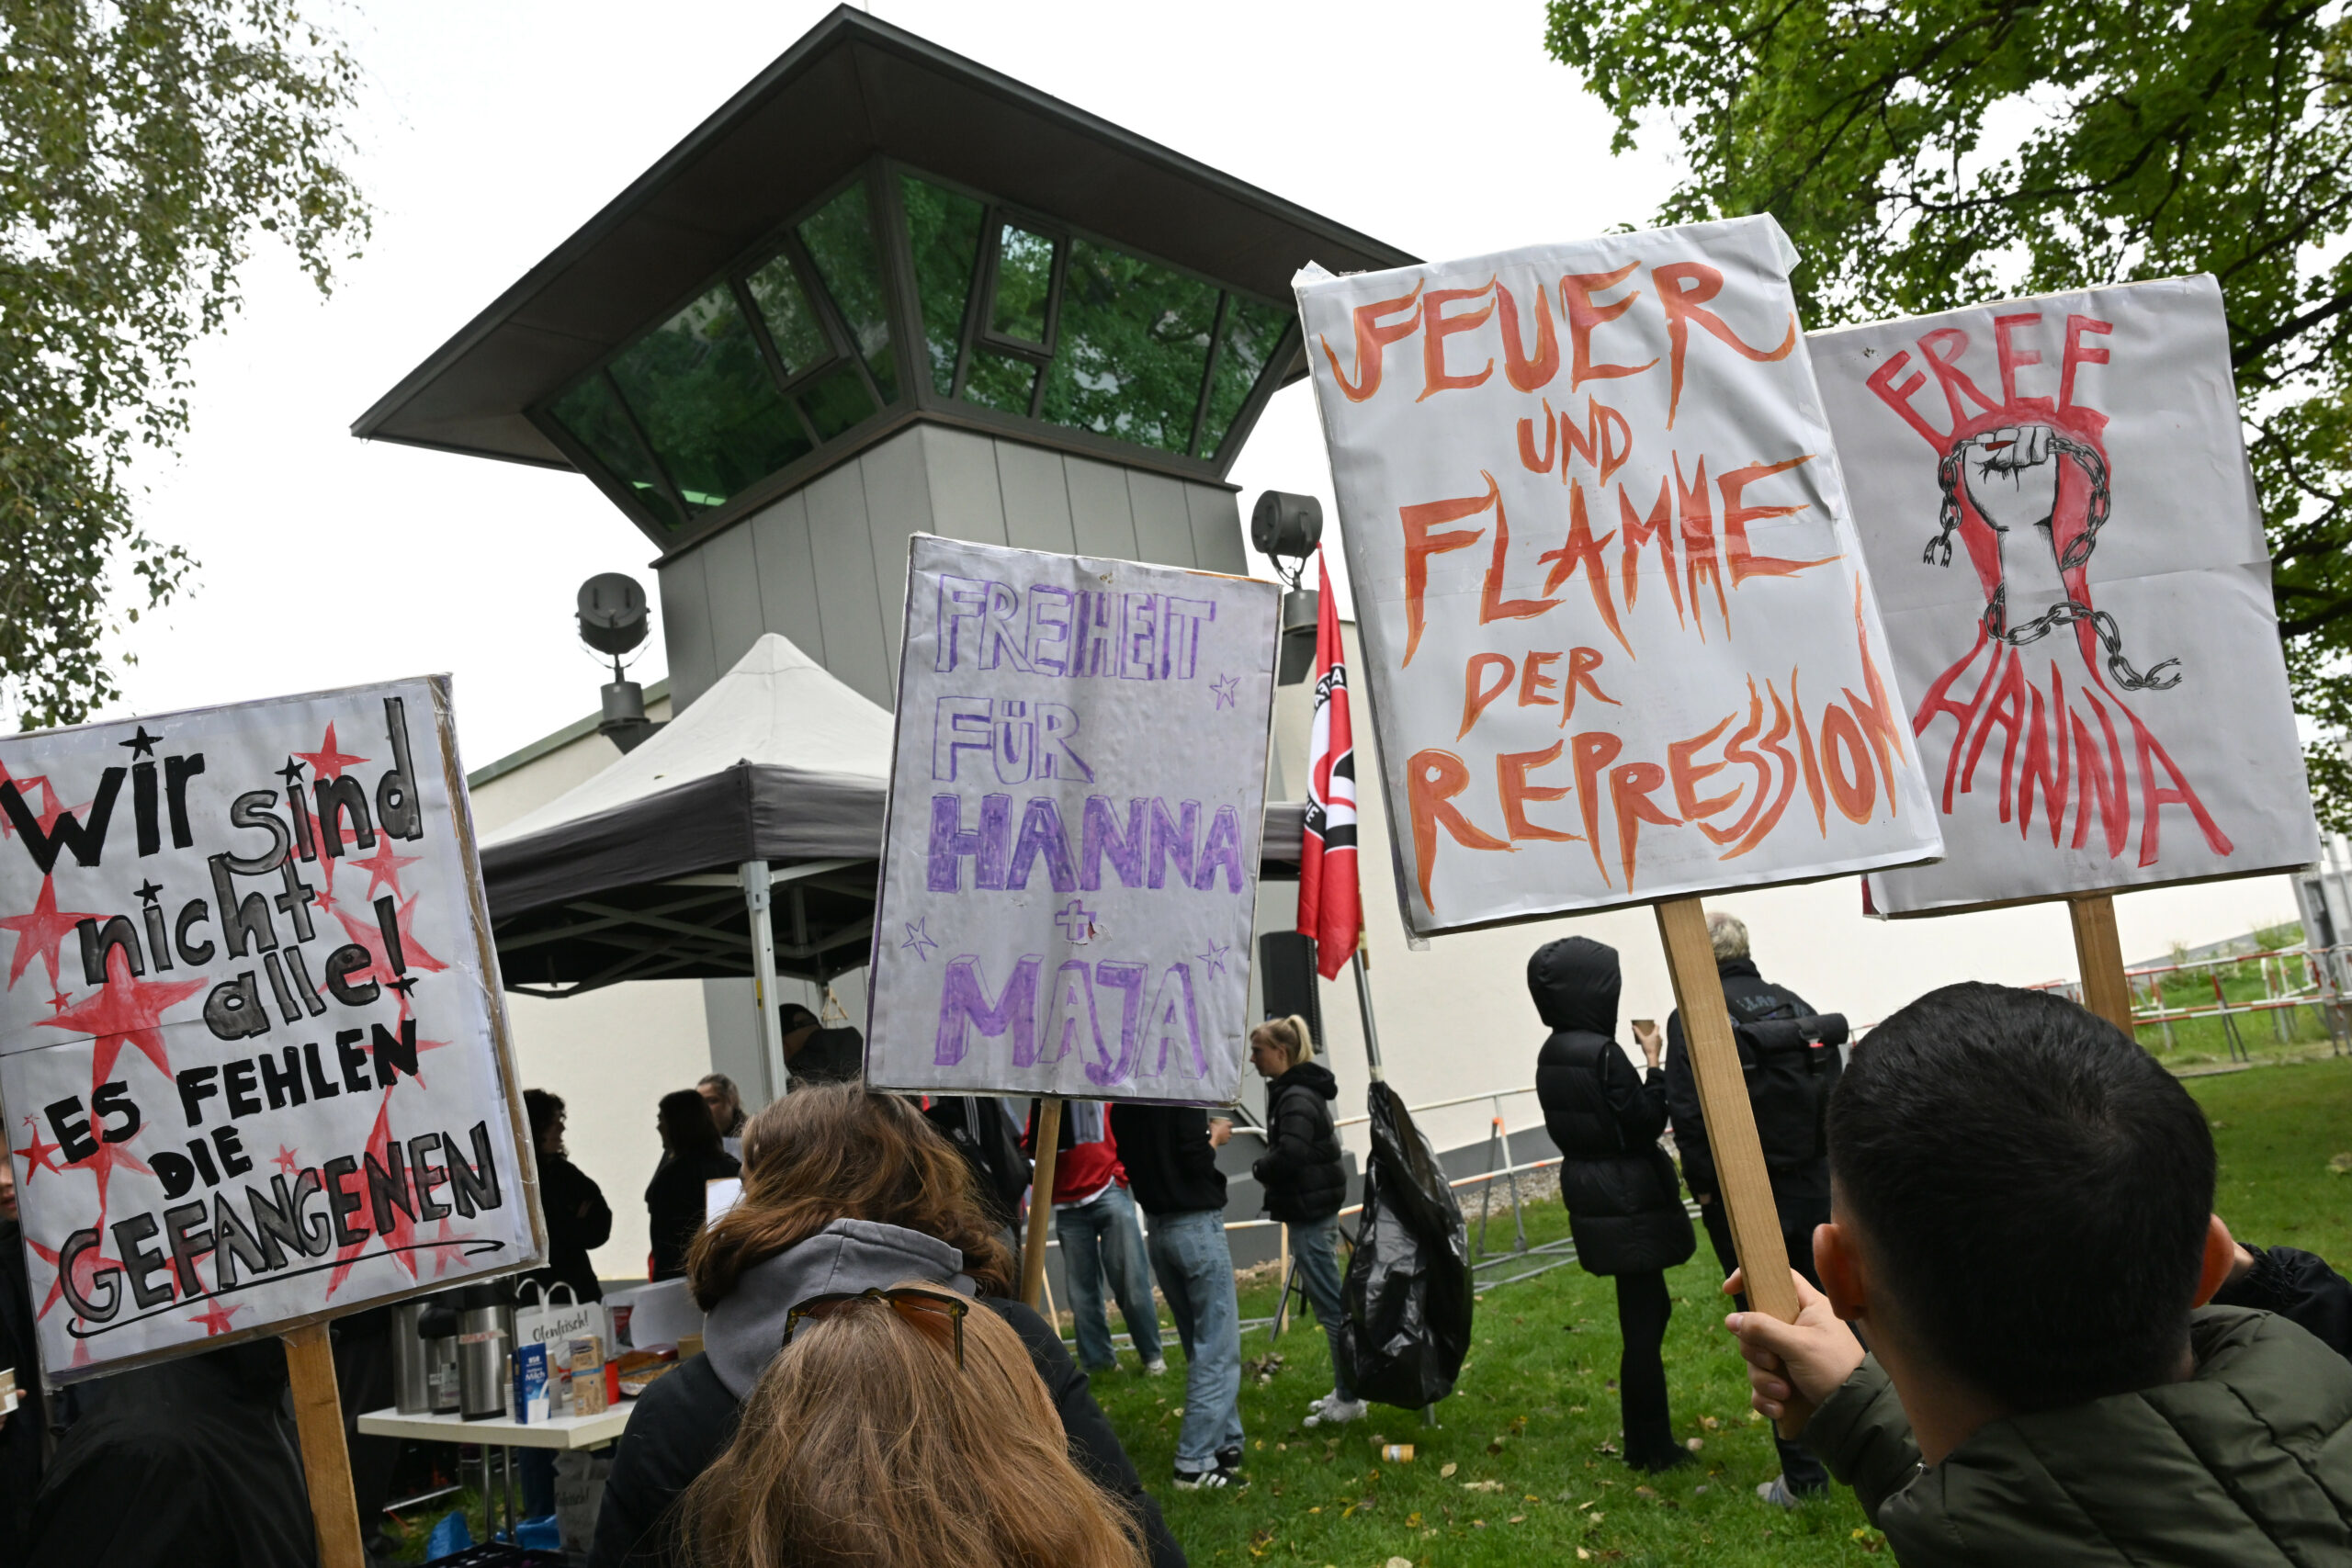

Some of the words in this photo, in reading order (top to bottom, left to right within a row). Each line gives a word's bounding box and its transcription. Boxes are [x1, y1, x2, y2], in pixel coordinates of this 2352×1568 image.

[1321, 260, 1795, 431] FEUER
[1866, 312, 2113, 438] FREE
[1517, 394, 1633, 487] UND
[1399, 449, 1847, 669] FLAMME
[935, 574, 1216, 681] FREIHEIT
[1456, 647, 1622, 741] DER
[222, 697, 423, 875] sind
[933, 696, 1094, 784] FÜR
[1407, 570, 1906, 915] REPRESSION
[1913, 618, 2233, 868] HANNA
[927, 794, 1244, 895] HANNA
[75, 853, 316, 985] nicht
[203, 896, 419, 1040] alle!
[933, 953, 1209, 1087] MAJA
[45, 1081, 141, 1165] ES
[176, 1020, 418, 1126] FEHLEN
[59, 1121, 502, 1323] GEFANGENEN
[147, 1125, 253, 1200] DIE
[532, 1309, 589, 1342] Ofenfrisch!
